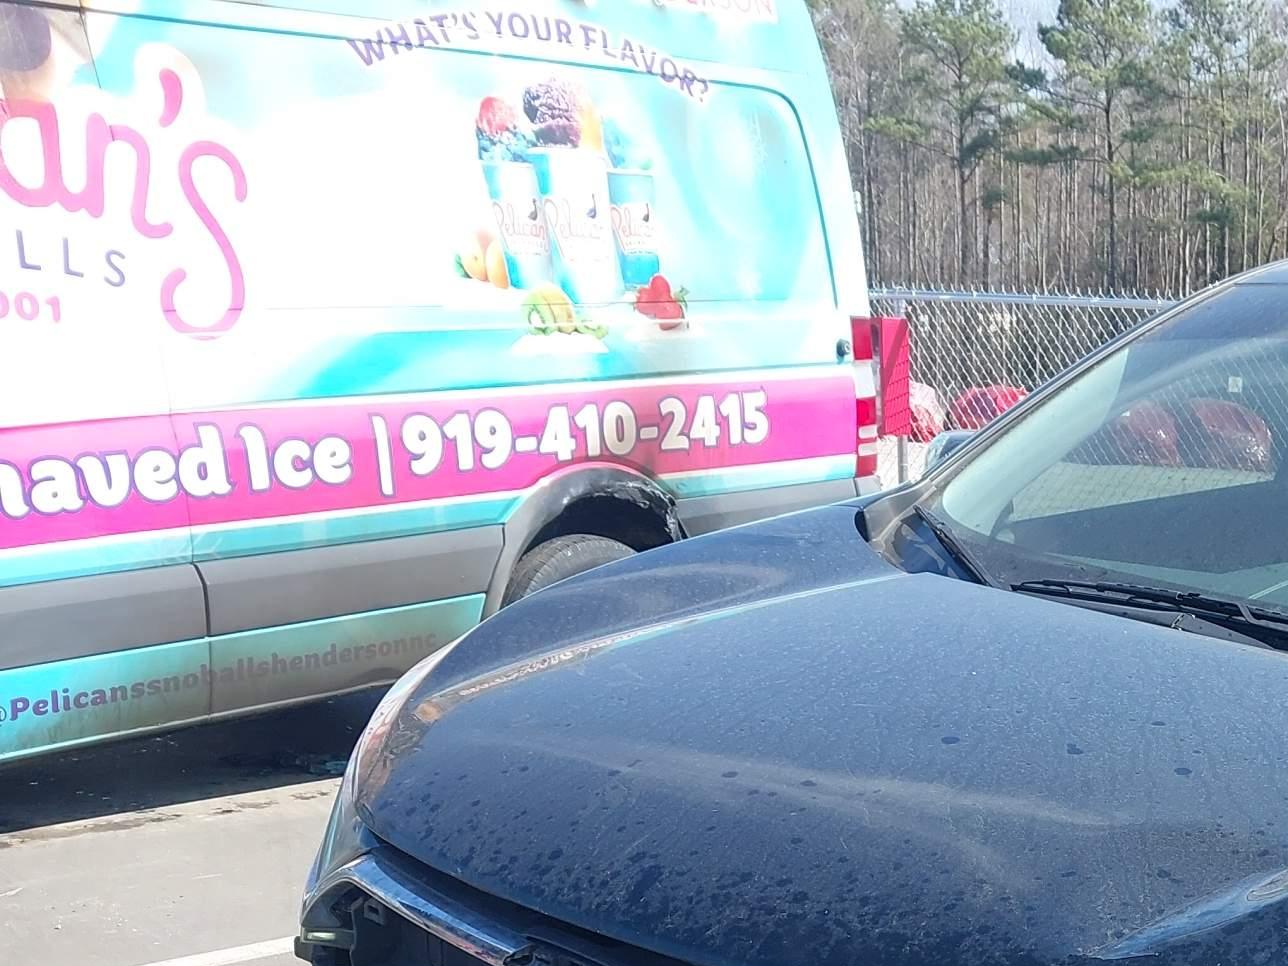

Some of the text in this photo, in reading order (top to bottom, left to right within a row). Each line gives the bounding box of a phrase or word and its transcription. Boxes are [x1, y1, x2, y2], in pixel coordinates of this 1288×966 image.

[347, 11, 710, 102] WHAT'S YOUR FLAVOR?
[237, 421, 353, 493] Ice
[400, 388, 770, 477] 919-410-2415
